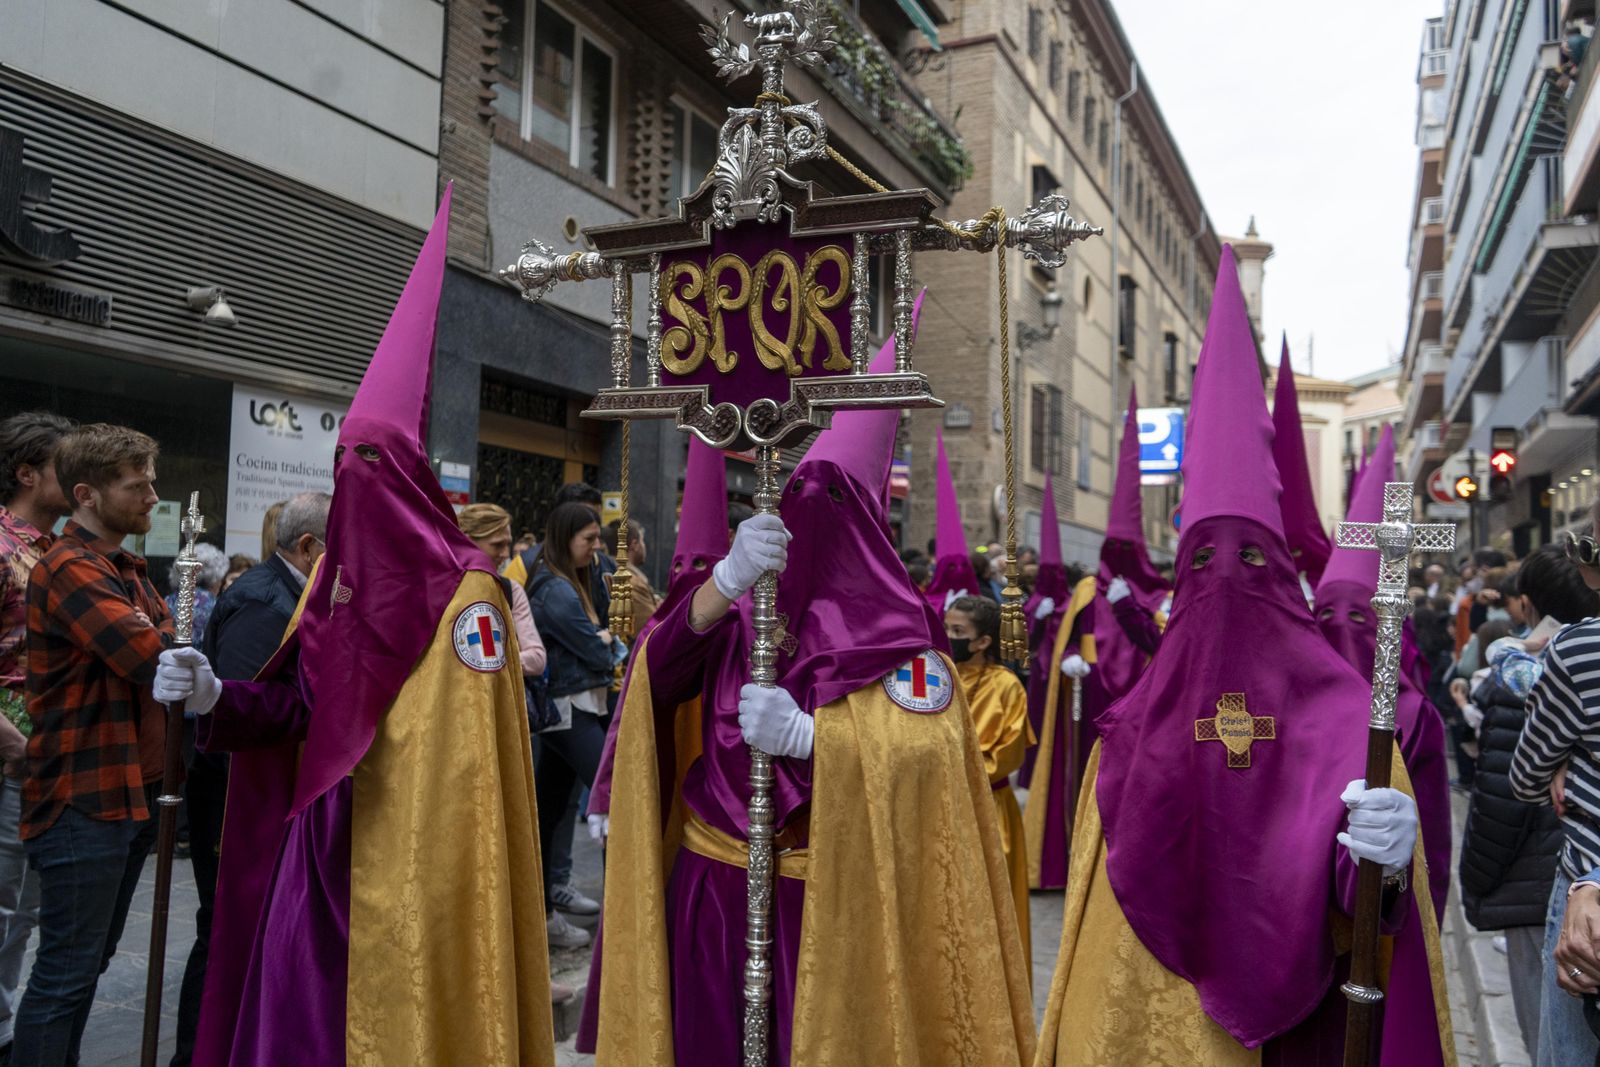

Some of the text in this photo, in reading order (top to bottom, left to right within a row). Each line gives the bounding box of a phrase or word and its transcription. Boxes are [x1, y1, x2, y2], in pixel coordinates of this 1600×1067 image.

[660, 244, 852, 376] SPQR
[236, 452, 334, 479] Cocina tradiciona
[237, 471, 276, 485] Traditional
[278, 478, 305, 488] Spanish
[1220, 716, 1251, 725] Christi
